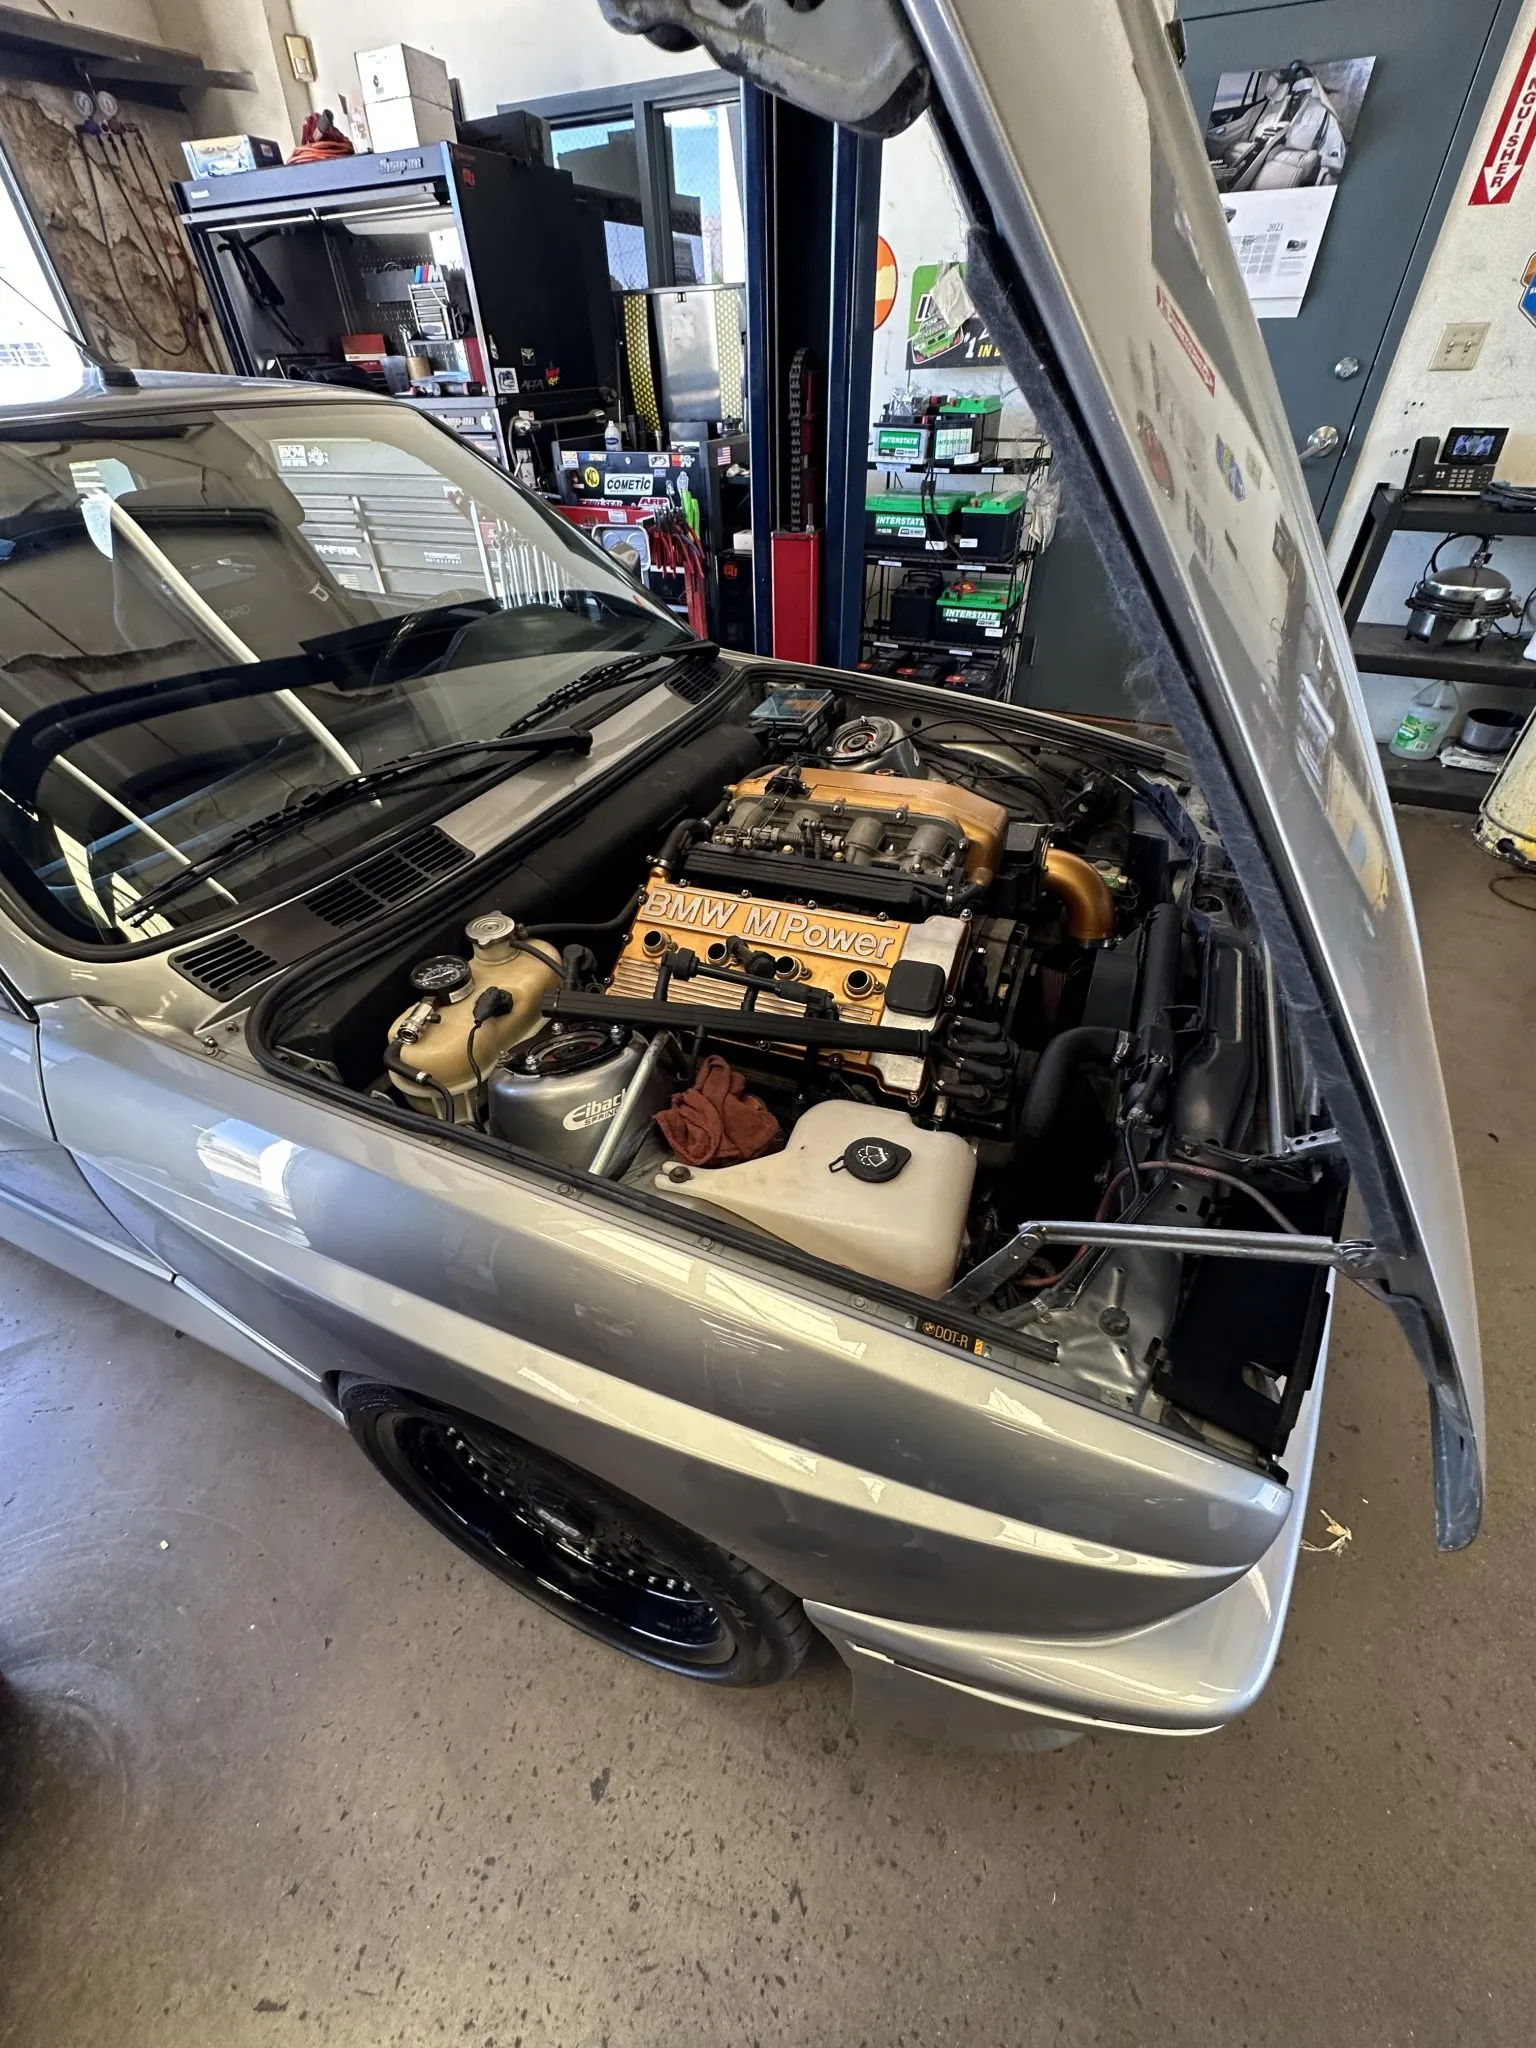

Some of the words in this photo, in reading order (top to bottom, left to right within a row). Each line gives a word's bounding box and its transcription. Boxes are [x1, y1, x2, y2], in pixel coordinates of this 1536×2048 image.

[881, 436, 919, 444] INTERSTATE
[586, 469, 599, 486] KC
[606, 476, 651, 490] COMETIC
[876, 515, 925, 526] INTERSTATE
[945, 608, 998, 620] INTERSTATE
[642, 888, 738, 930] BMW
[935, 1325, 969, 1349] DOT-R
